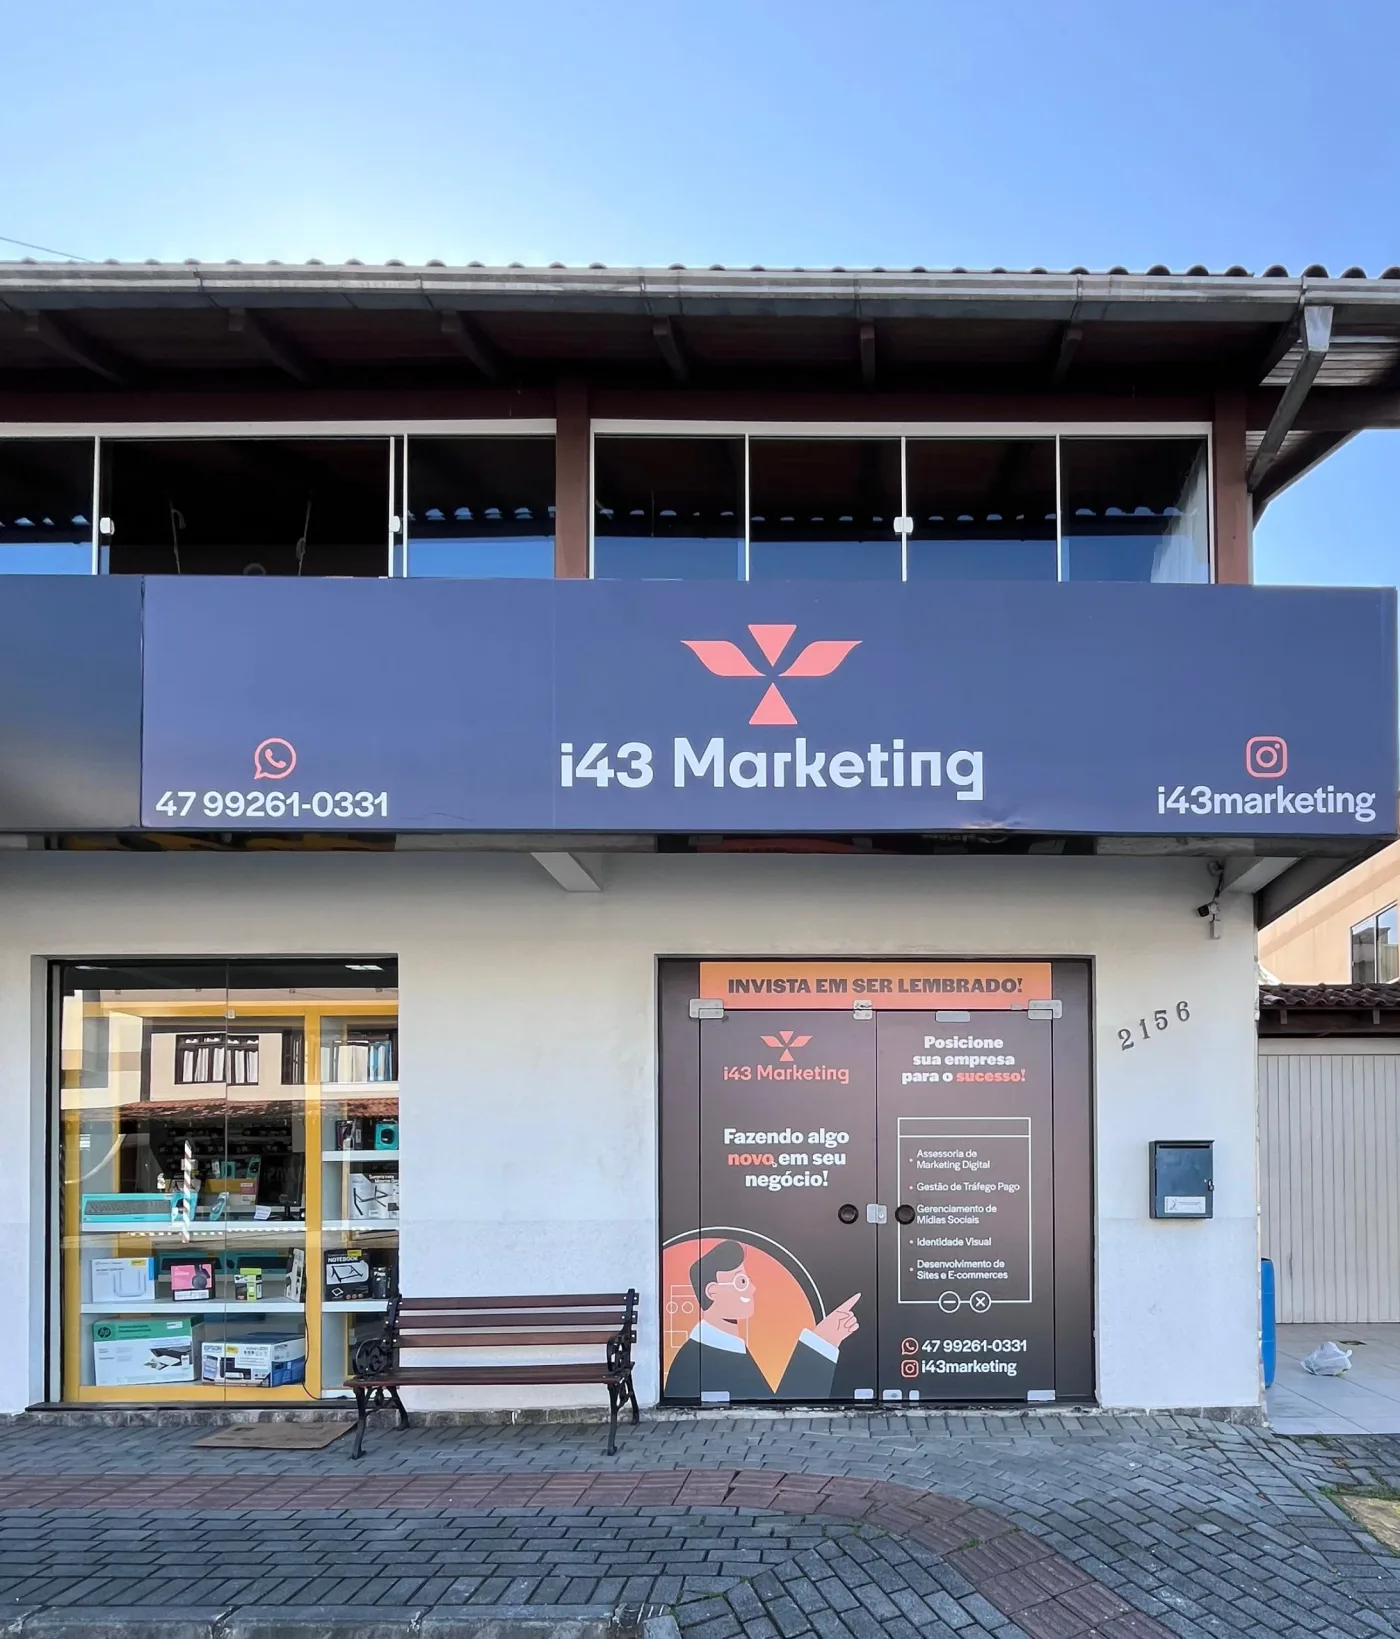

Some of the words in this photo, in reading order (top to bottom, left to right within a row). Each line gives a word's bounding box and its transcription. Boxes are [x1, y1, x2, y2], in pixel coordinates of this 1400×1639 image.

[560, 742, 654, 788] i43
[673, 737, 985, 801] Marketing
[155, 791, 196, 817] 47
[203, 791, 388, 818] 99261-0331
[1157, 785, 1377, 823] i43marketing
[728, 978, 811, 994] INVISTA
[815, 978, 848, 994] EM
[852, 978, 893, 993] SER
[898, 977, 1023, 993] LEMBRADO!
[1117, 1000, 1190, 1051] 2156
[924, 1035, 1004, 1050] Posicione
[912, 1054, 942, 1066] sua
[946, 1054, 1015, 1067] empresa
[723, 1065, 752, 1081] i43
[757, 1065, 850, 1084] Marketing
[901, 1071, 938, 1085] para
[942, 1071, 953, 1083] o
[956, 1068, 1026, 1083] sucesso!
[723, 1128, 804, 1144] Fazendo
[807, 1128, 850, 1148] algo
[727, 1153, 775, 1166] novo
[778, 1153, 809, 1165] em
[812, 1153, 847, 1165] seu
[916, 1149, 964, 1158] Assessoria
[965, 1149, 978, 1158] de
[916, 1161, 961, 1171] Marketing
[962, 1160, 991, 1171] Digital
[745, 1170, 829, 1192] negócio!
[916, 1182, 948, 1192] Gestão
[950, 1183, 962, 1192] de
[963, 1182, 997, 1194] Tráfego
[998, 1183, 1021, 1194] Pago
[916, 1204, 984, 1214] Gerenciamento
[985, 1204, 998, 1214] de
[916, 1215, 947, 1225] Mídias
[948, 1215, 980, 1225] Sociais
[916, 1237, 965, 1247] Identidade
[965, 1237, 992, 1247] Visual
[916, 1260, 992, 1269] Desenvolvimento
[993, 1260, 1005, 1269] de
[916, 1270, 940, 1280] Sites
[940, 1272, 947, 1280] e
[948, 1271, 1008, 1280] E-commerces
[921, 1339, 941, 1353] 47
[943, 1339, 1027, 1353] 99261-0331
[921, 1359, 1017, 1377] i43marketing
